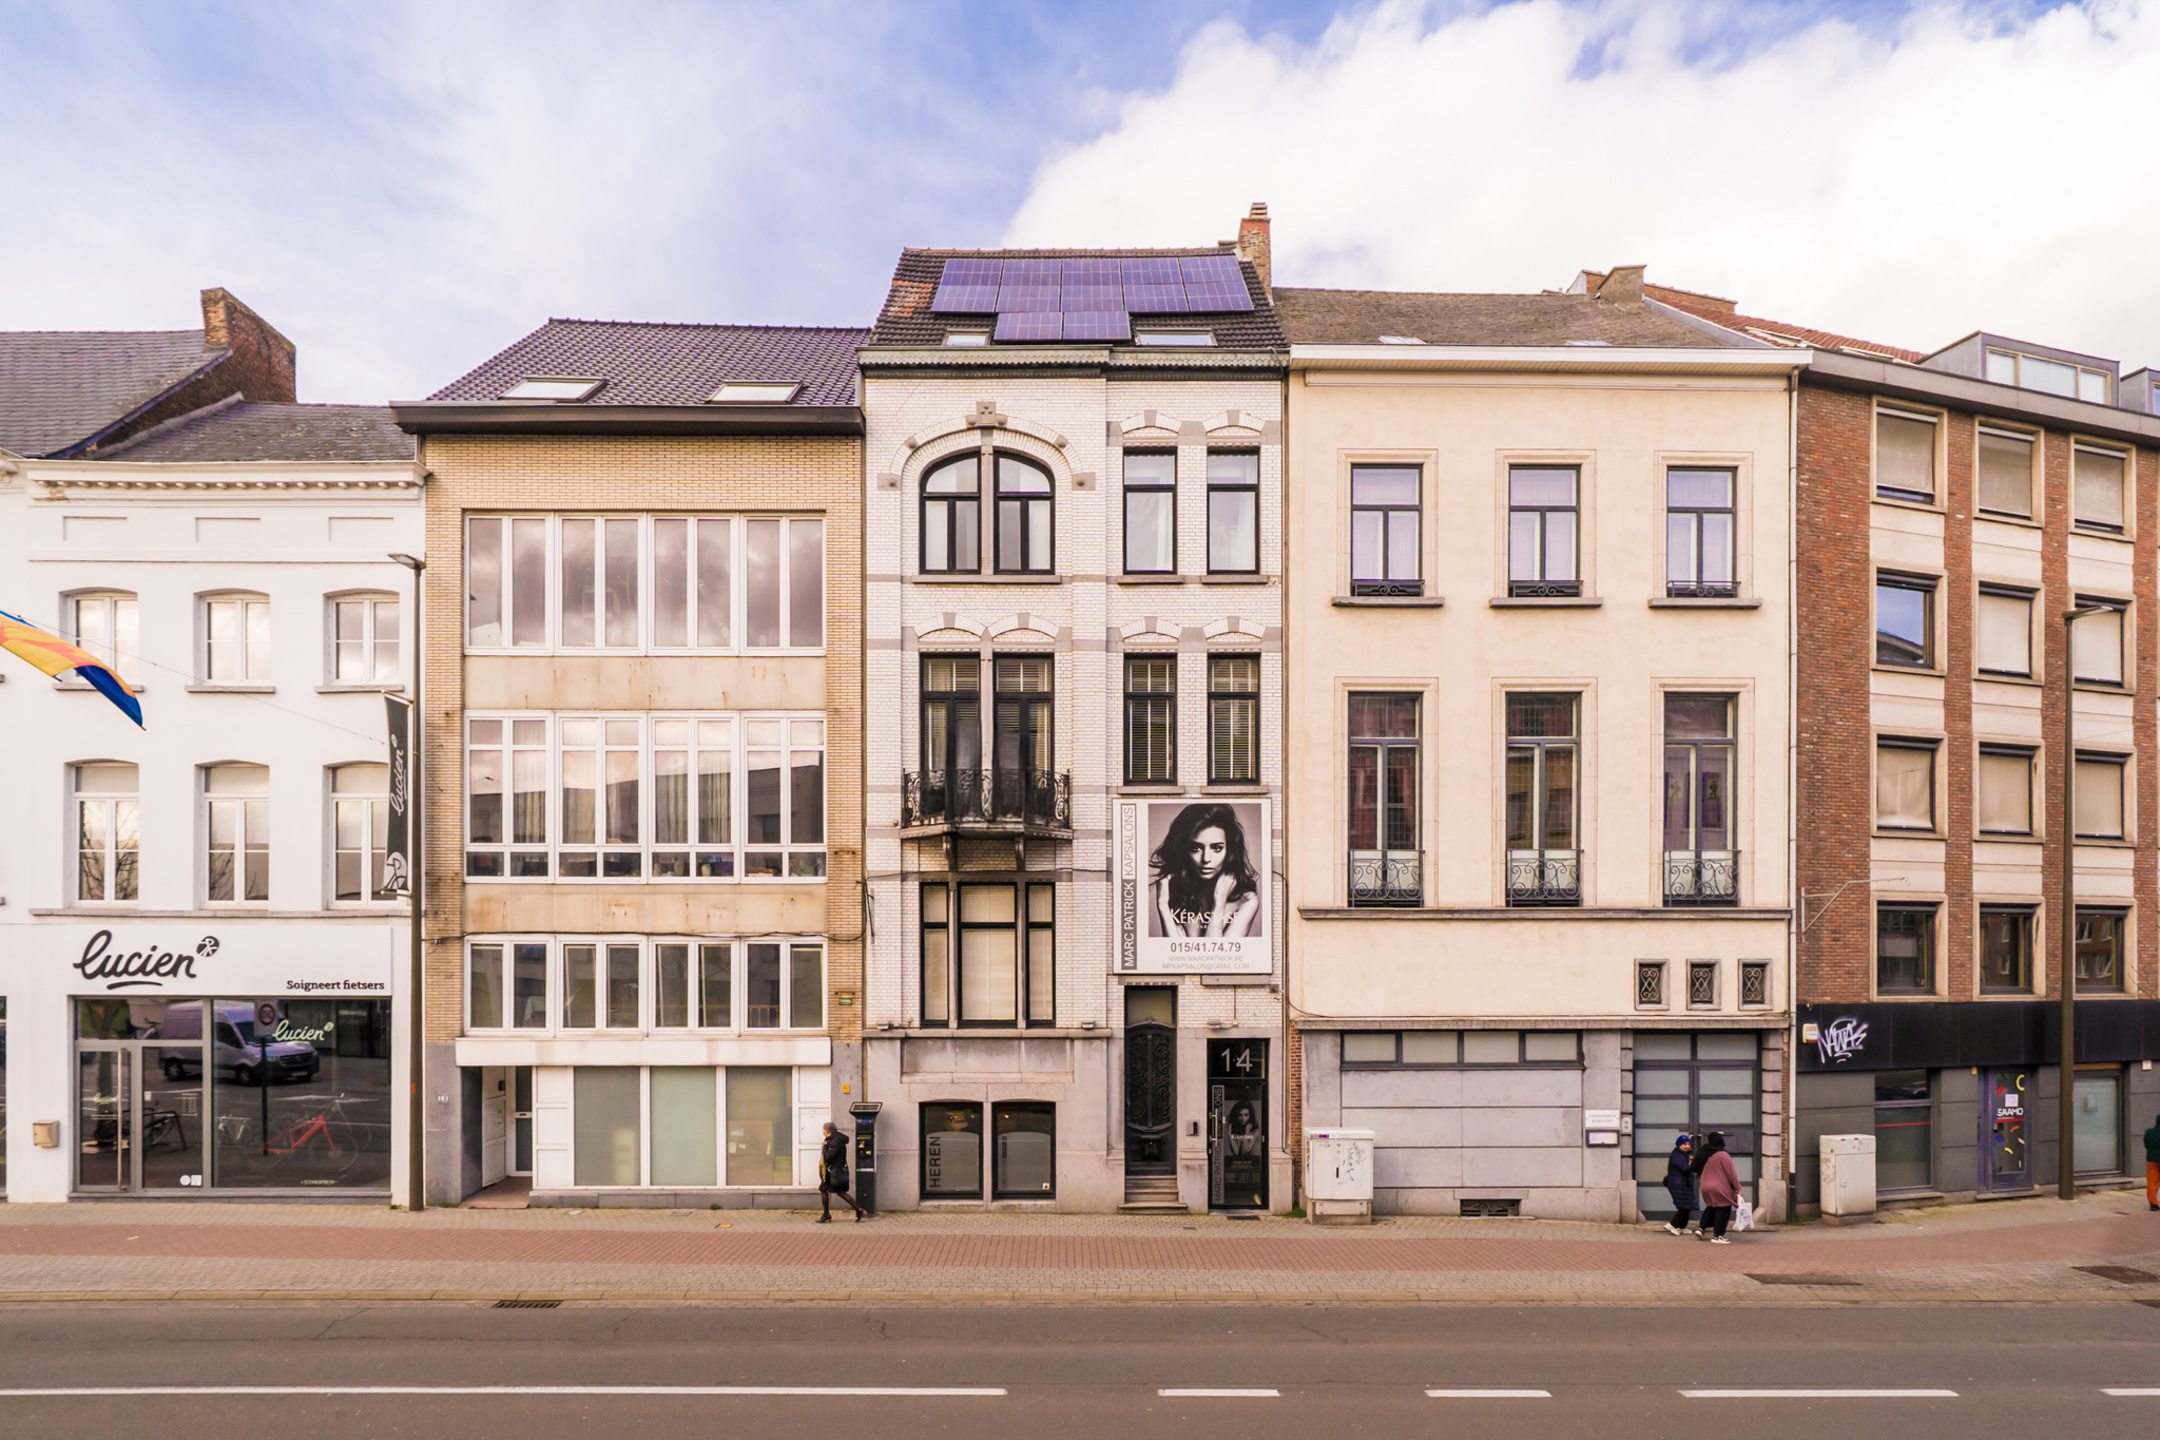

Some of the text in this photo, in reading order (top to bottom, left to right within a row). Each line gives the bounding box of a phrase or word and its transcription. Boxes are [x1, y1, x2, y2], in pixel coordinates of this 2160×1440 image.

[389, 748, 405, 816] lucien
[1124, 807, 1134, 967] MARC PATRICK KAPSALONS
[73, 929, 197, 980] lucien
[1170, 942, 1241, 953] 015/41.74.79
[286, 979, 385, 992] Soigneert fietsers
[272, 1019, 325, 1041] lucien
[1221, 1047, 1253, 1072] 14
[1996, 1107, 2024, 1117] SAAMO
[929, 1136, 941, 1188] HEREN
[1214, 1177, 1222, 1201] MARC
